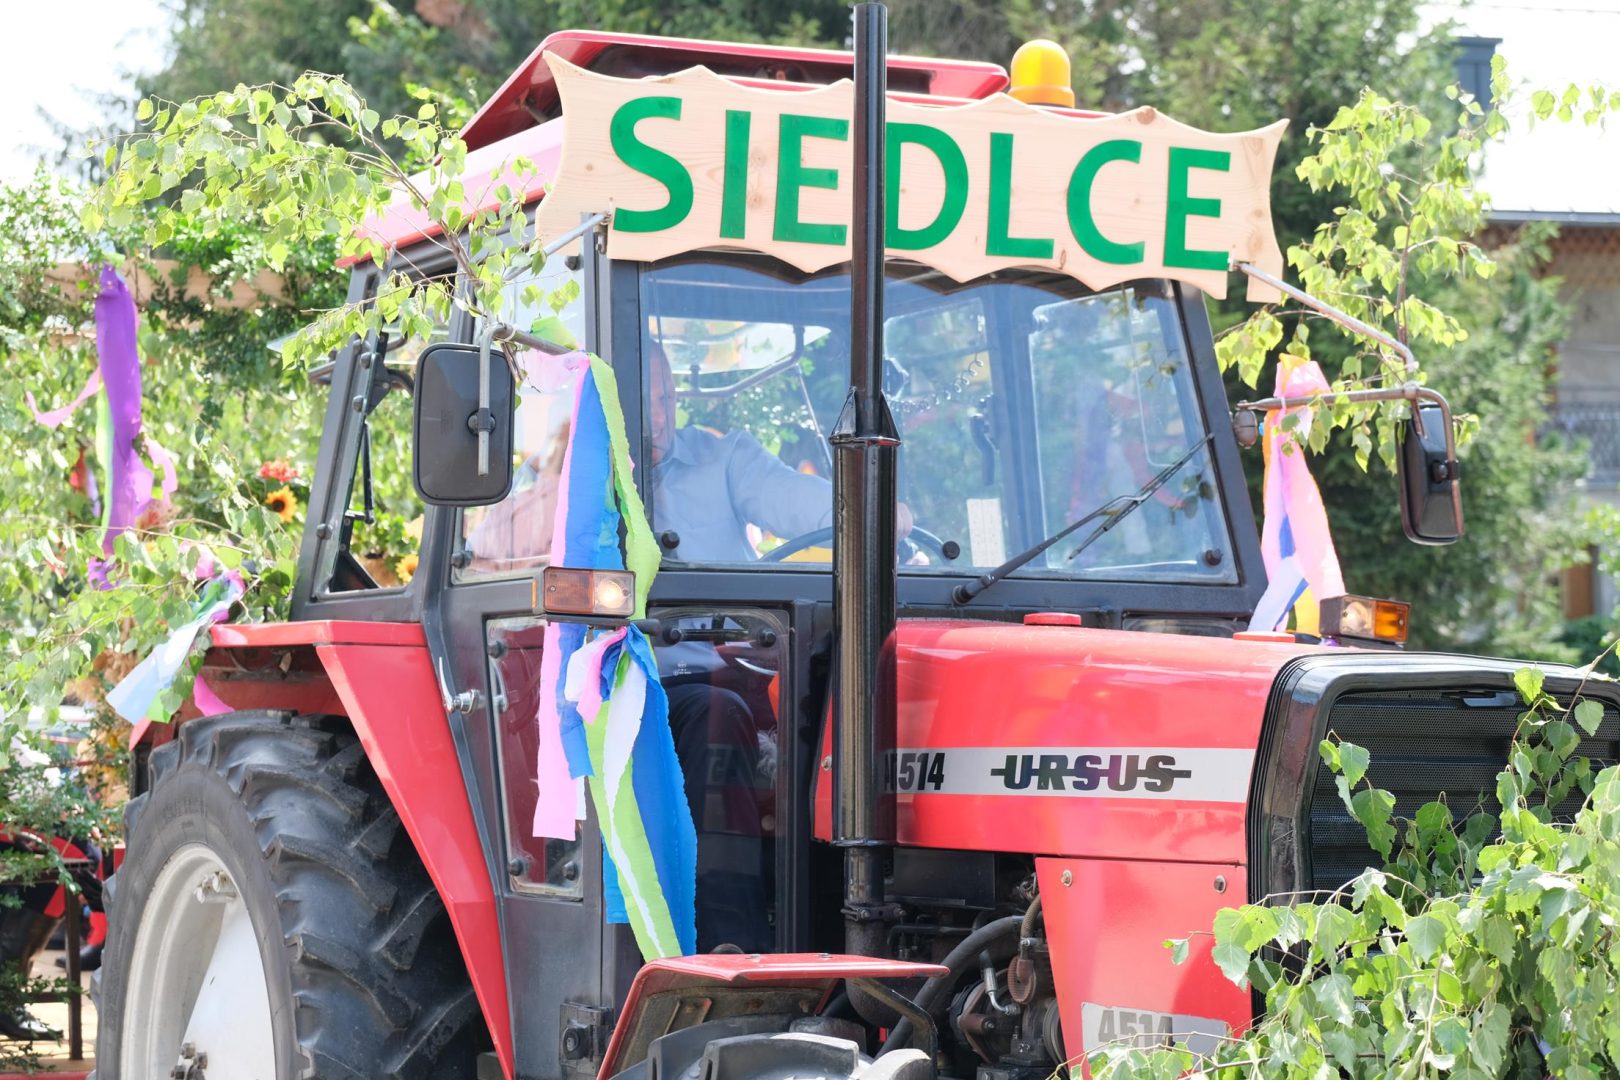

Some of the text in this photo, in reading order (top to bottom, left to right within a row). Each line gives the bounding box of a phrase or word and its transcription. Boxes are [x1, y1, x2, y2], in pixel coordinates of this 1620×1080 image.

[609, 96, 1231, 270] SIEDLCE
[897, 752, 1191, 792] 514 URSUS
[1098, 1010, 1174, 1052] 4514
